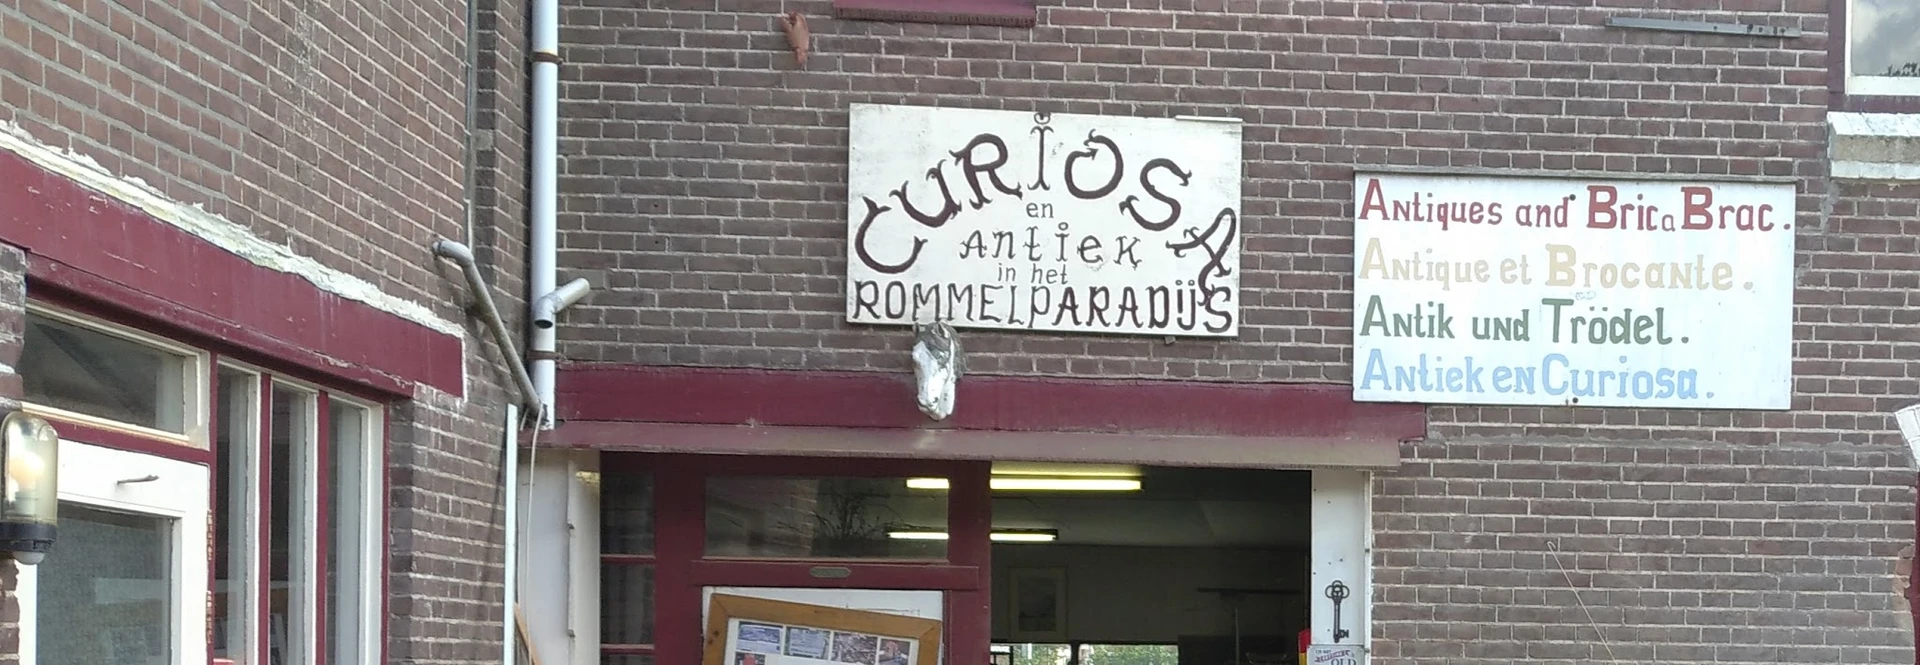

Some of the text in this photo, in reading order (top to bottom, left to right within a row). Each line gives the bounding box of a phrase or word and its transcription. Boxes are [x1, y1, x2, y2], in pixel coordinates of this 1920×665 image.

[1026, 201, 1054, 219] en
[1358, 178, 1791, 232] Antiques and Bric a Brac.
[997, 263, 1068, 285] in het
[1358, 237, 1754, 291] Antique et Brocante.
[1359, 294, 1690, 344] Antik und Trödel.
[1360, 348, 1715, 399] Antiek en Curiosa.
